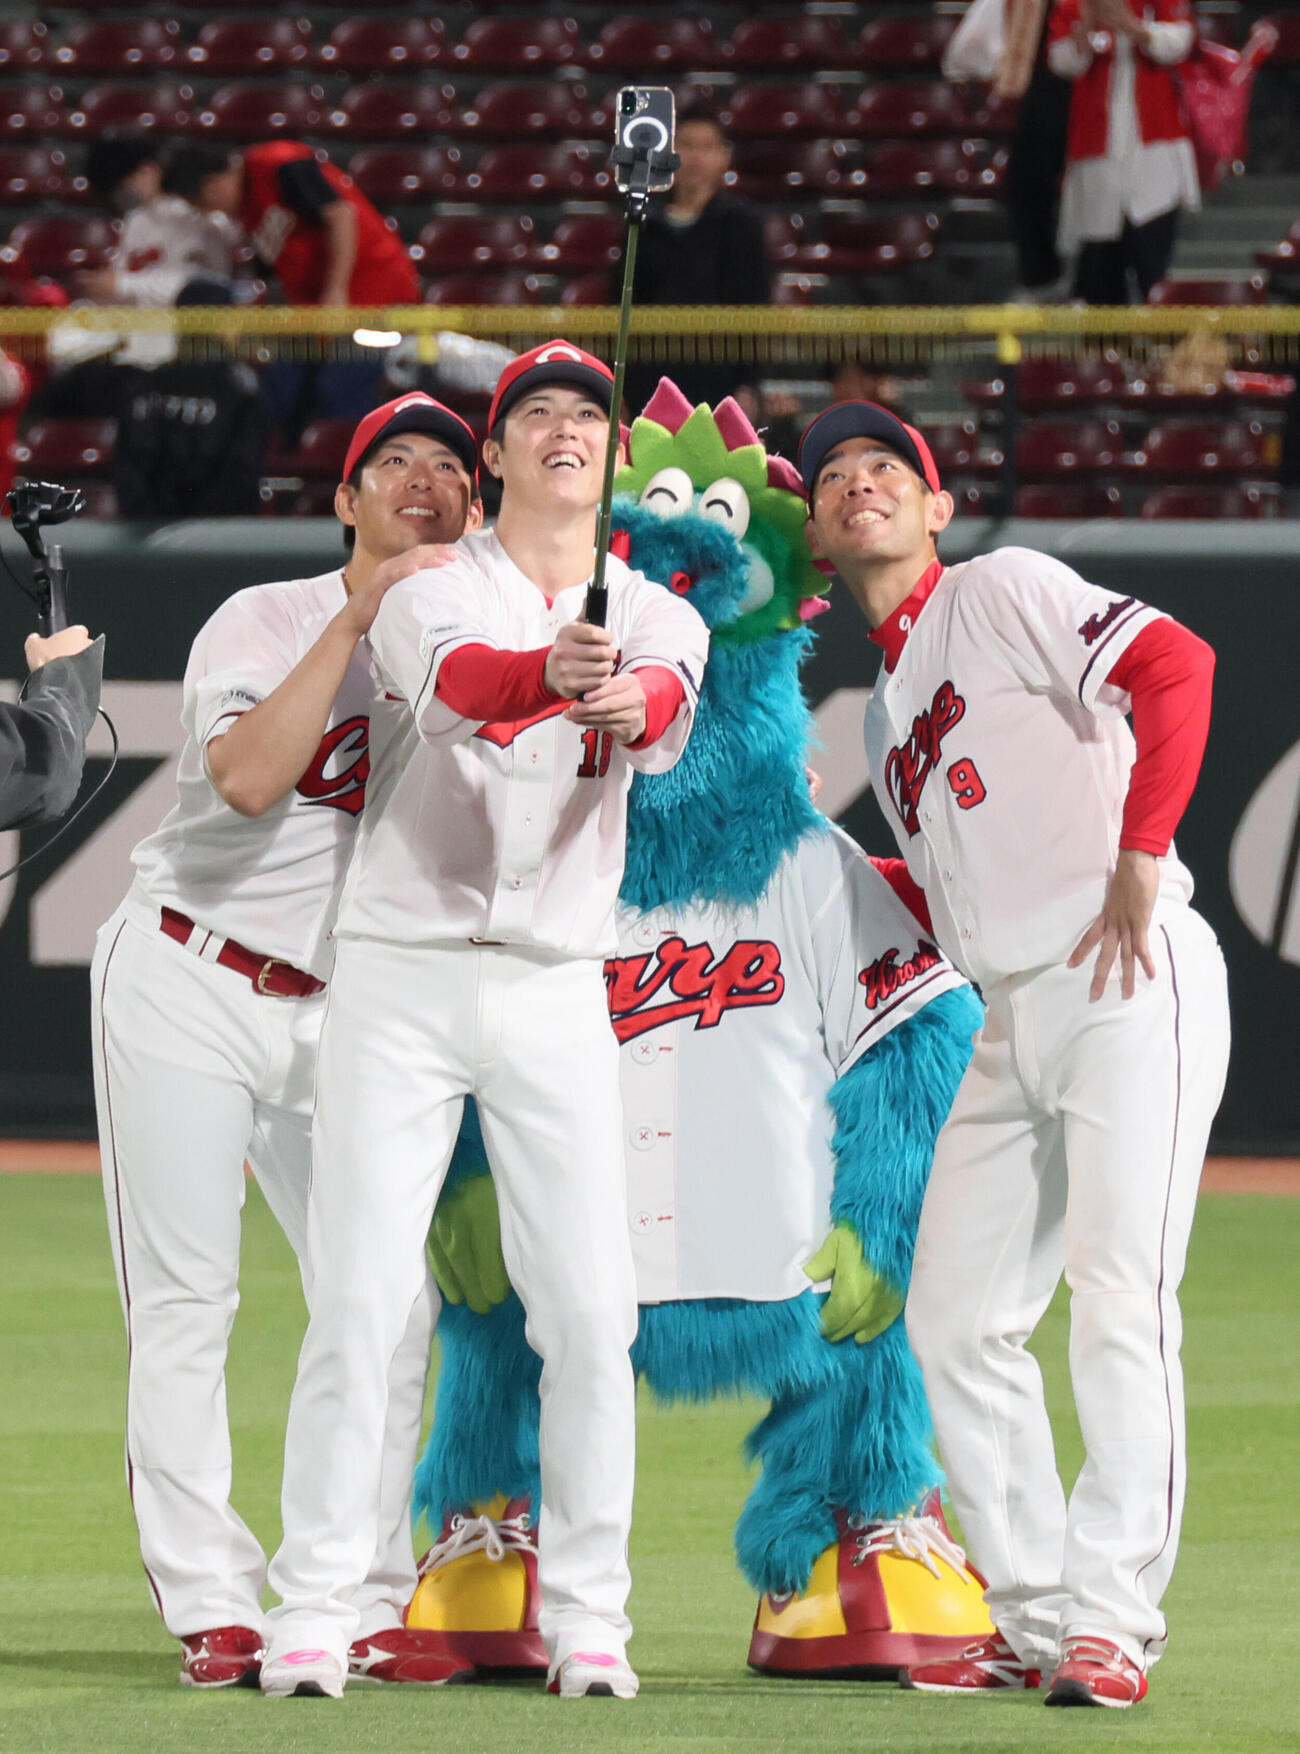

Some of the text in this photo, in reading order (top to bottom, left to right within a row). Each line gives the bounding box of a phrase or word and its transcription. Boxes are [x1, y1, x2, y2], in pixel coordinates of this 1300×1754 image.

[884, 680, 967, 842] Carp
[946, 757, 988, 811] 9
[603, 936, 786, 1047] arp
